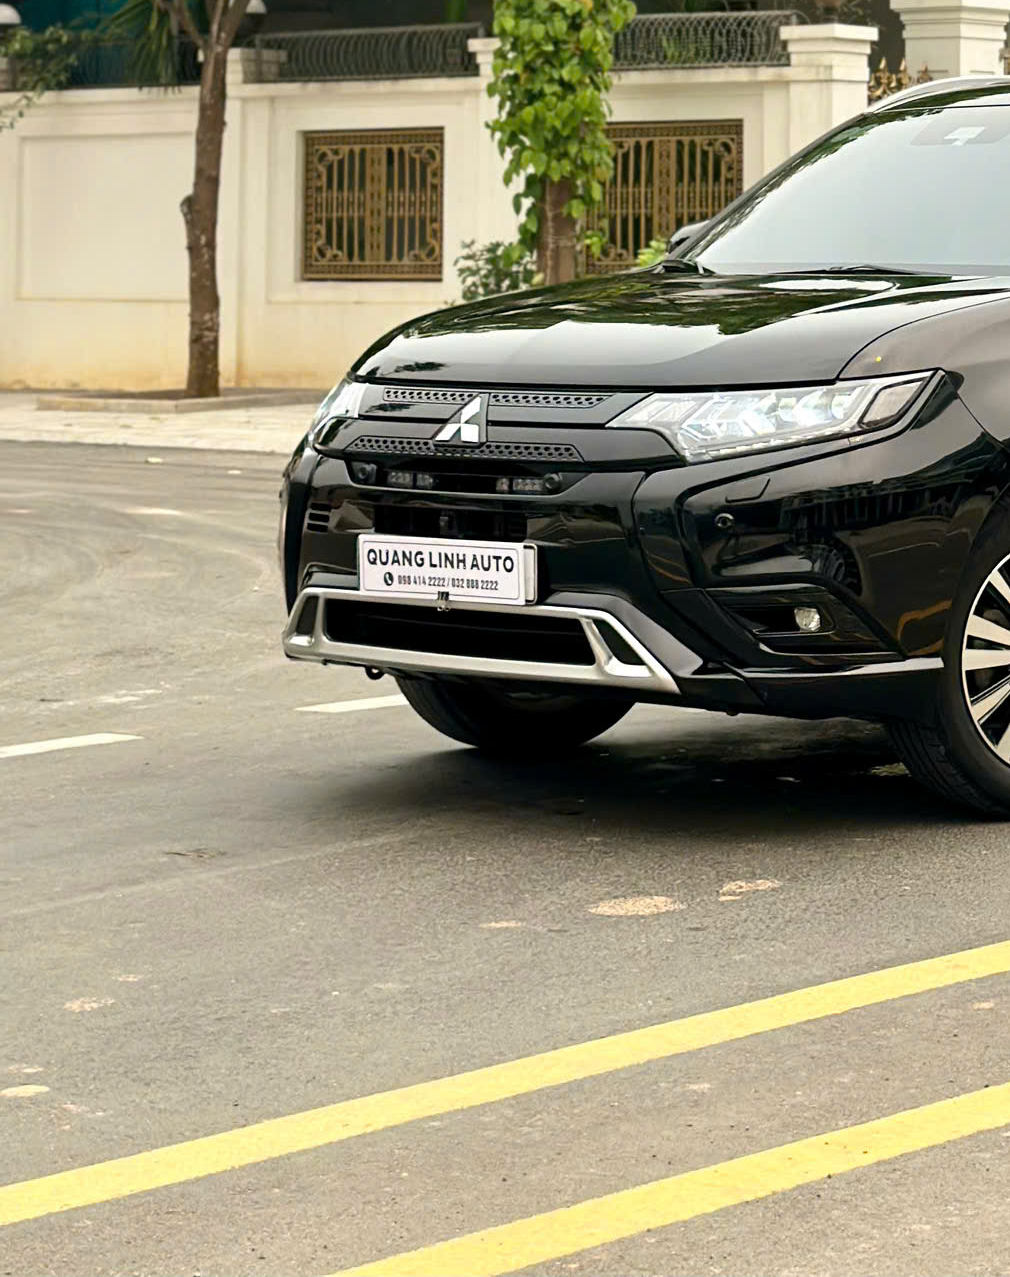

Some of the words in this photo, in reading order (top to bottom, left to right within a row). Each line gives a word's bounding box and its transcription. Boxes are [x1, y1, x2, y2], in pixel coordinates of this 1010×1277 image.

[367, 548, 425, 567] QUANG
[429, 551, 466, 570] LINH
[470, 554, 514, 573] AUTO
[413, 576, 426, 585] 414
[428, 576, 446, 587] 2222
[451, 578, 465, 588] 032
[481, 580, 499, 590] 2222
